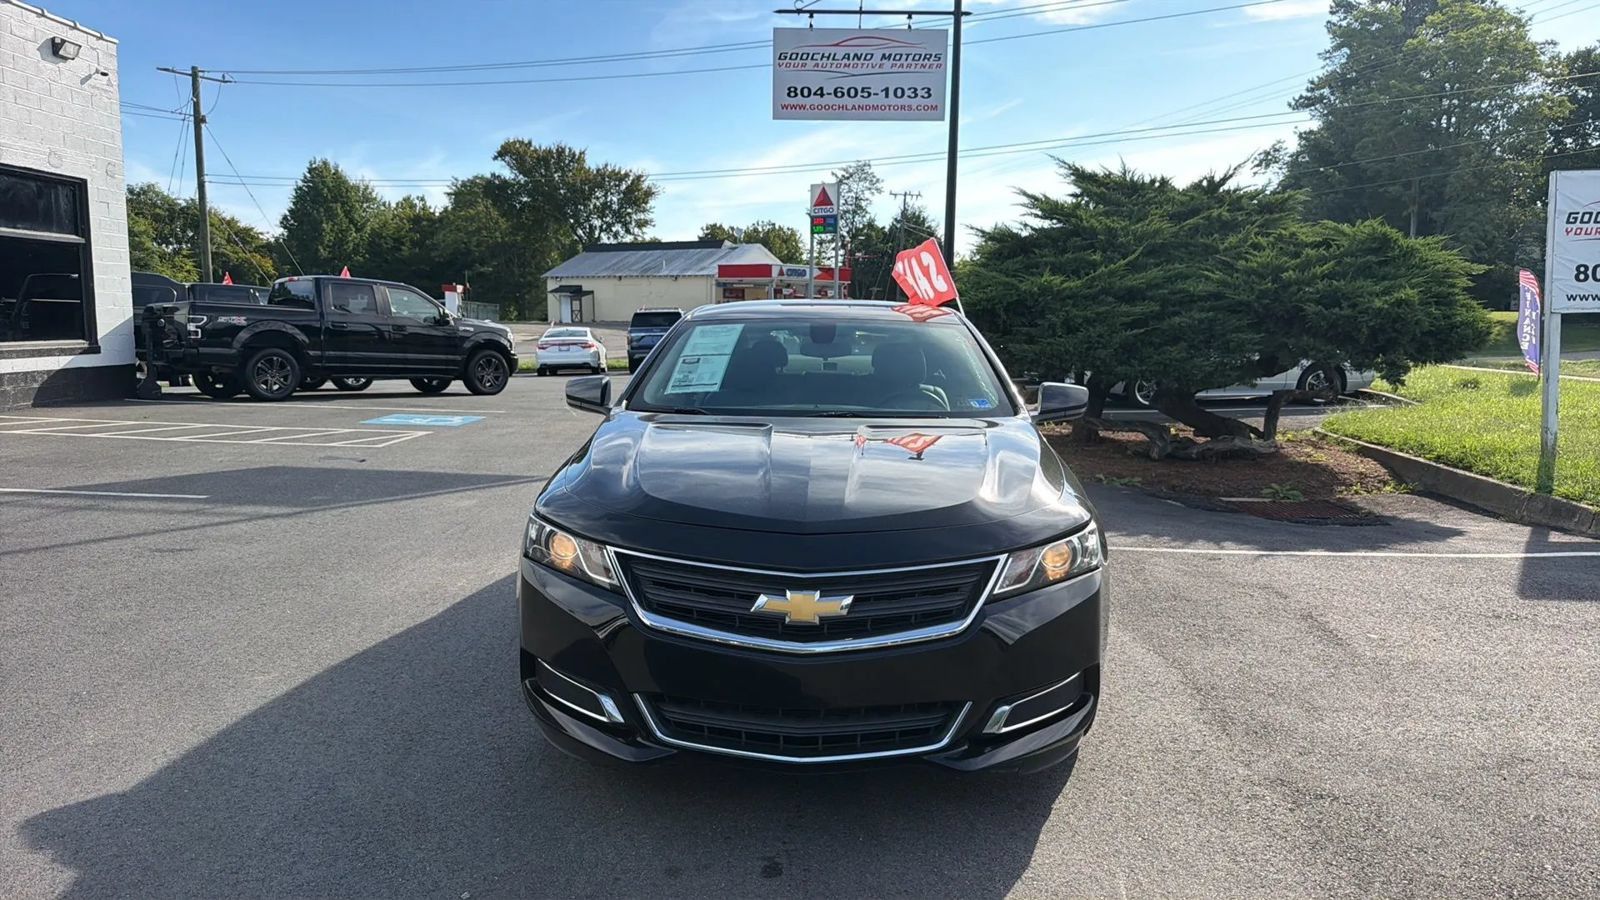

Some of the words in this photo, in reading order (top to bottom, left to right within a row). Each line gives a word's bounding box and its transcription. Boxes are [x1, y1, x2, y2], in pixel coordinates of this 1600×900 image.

[778, 52, 874, 61] GOOCHLAND
[880, 53, 942, 62] MOTORS
[786, 86, 933, 99] 804-605-1033
[780, 103, 938, 112] WWW.GOOCHLANDMOTORS.COM
